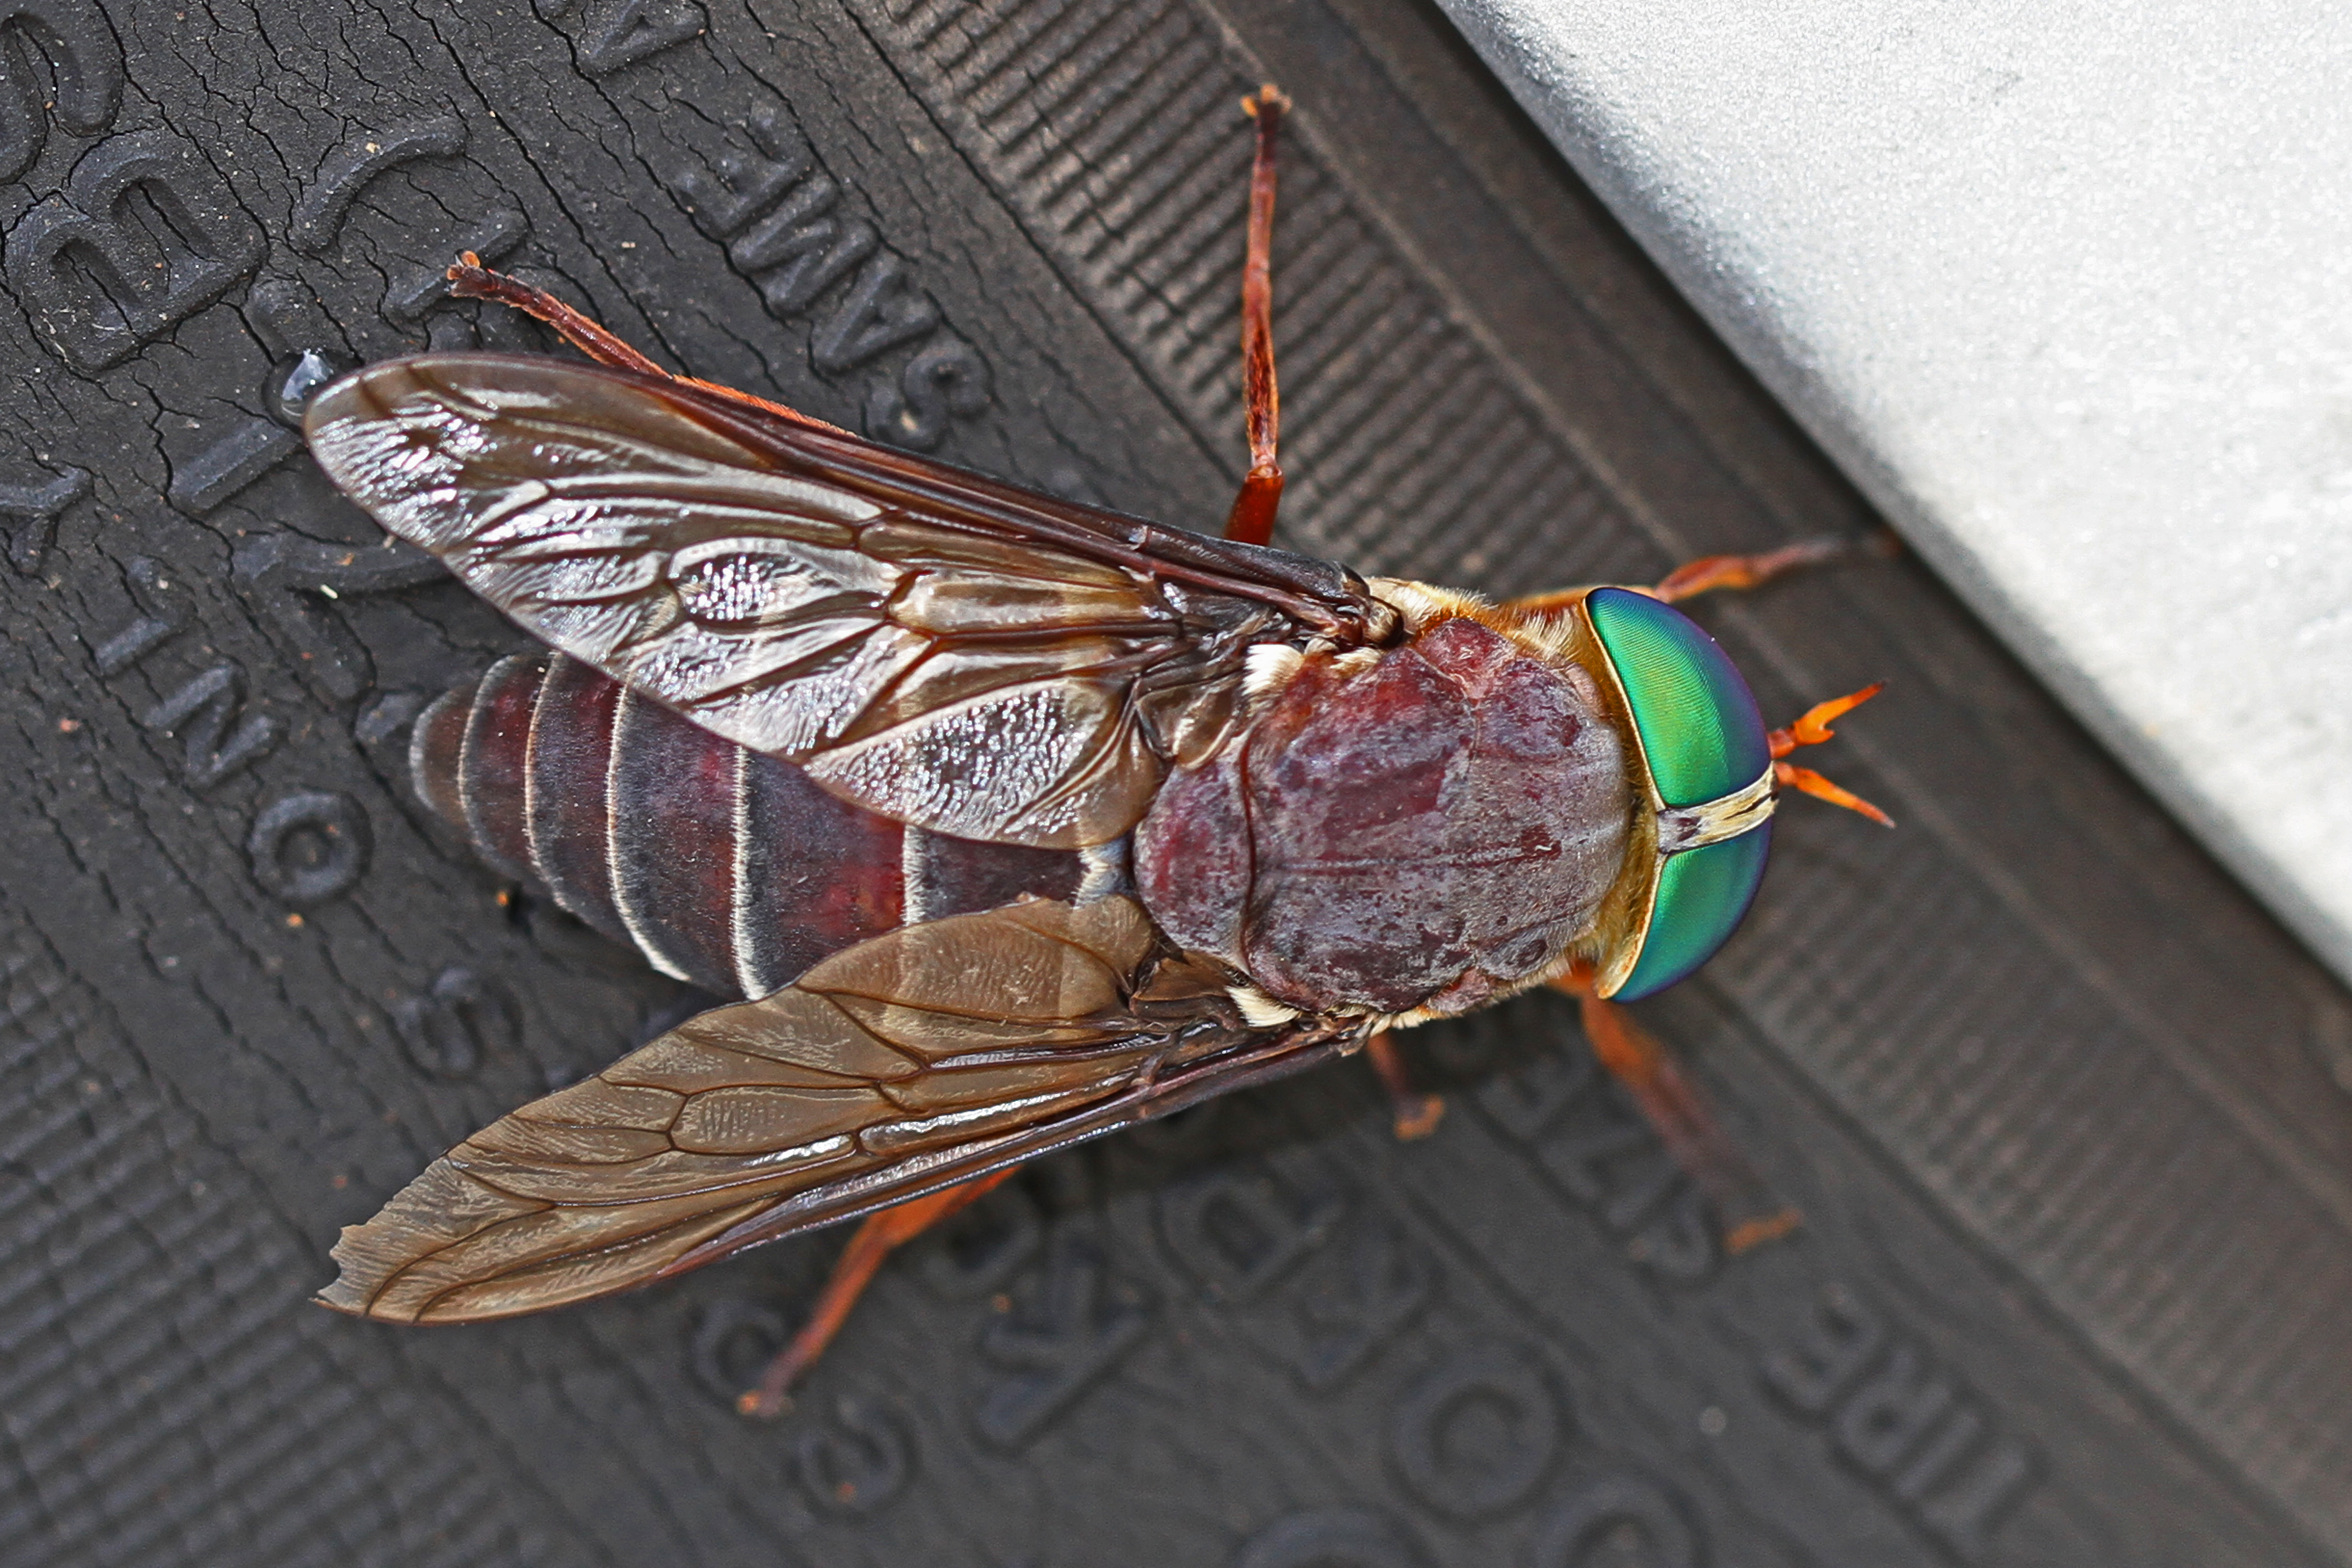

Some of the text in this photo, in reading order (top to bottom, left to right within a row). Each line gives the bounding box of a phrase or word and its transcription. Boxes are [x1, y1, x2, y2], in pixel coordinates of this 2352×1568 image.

[675, 96, 990, 450] SAME
[0, 461, 363, 902] ONLY
[1763, 1282, 2030, 1543] TIRE
